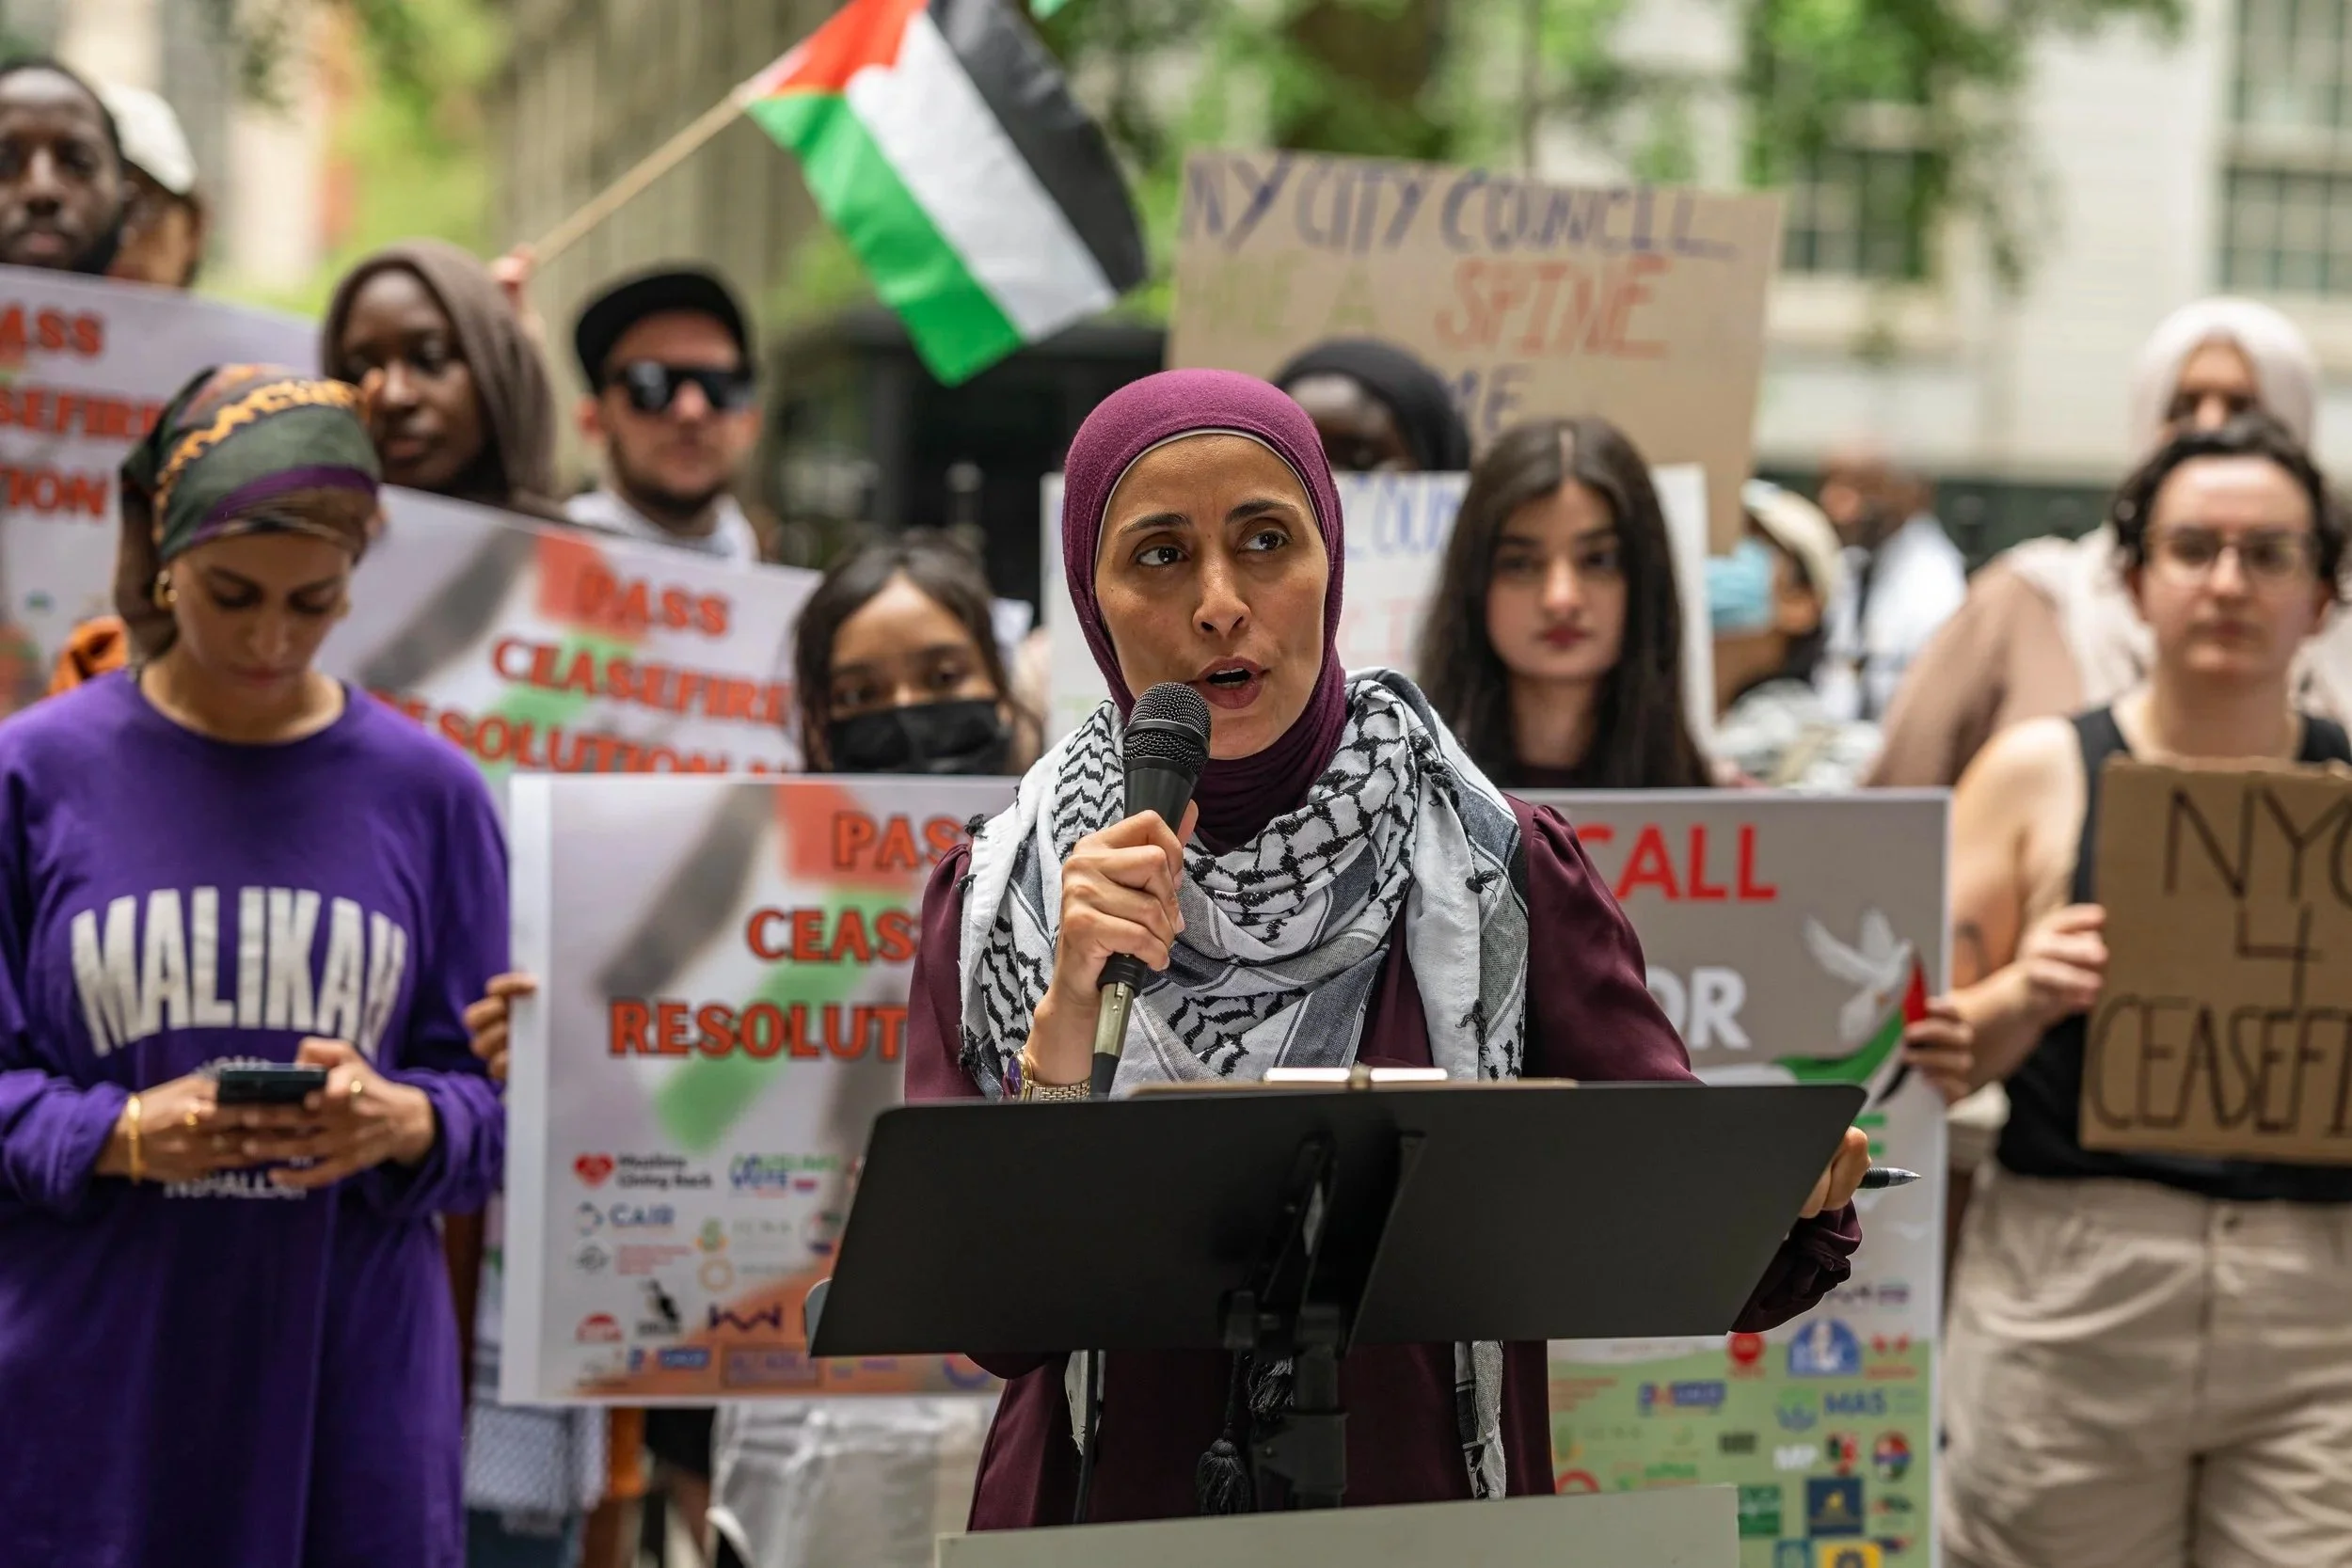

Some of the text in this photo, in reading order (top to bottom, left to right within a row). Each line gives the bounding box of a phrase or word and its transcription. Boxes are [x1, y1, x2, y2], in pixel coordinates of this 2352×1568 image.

[1186, 154, 1740, 261] NY CITY COUNCIL
[1434, 254, 1673, 359] SPINE
[574, 567, 732, 636] PASS
[493, 640, 791, 728] CEASEFIRE
[2235, 903, 2326, 1018] 4
[609, 1001, 908, 1060] RESOLUT
[610, 1203, 675, 1227] CAIR
